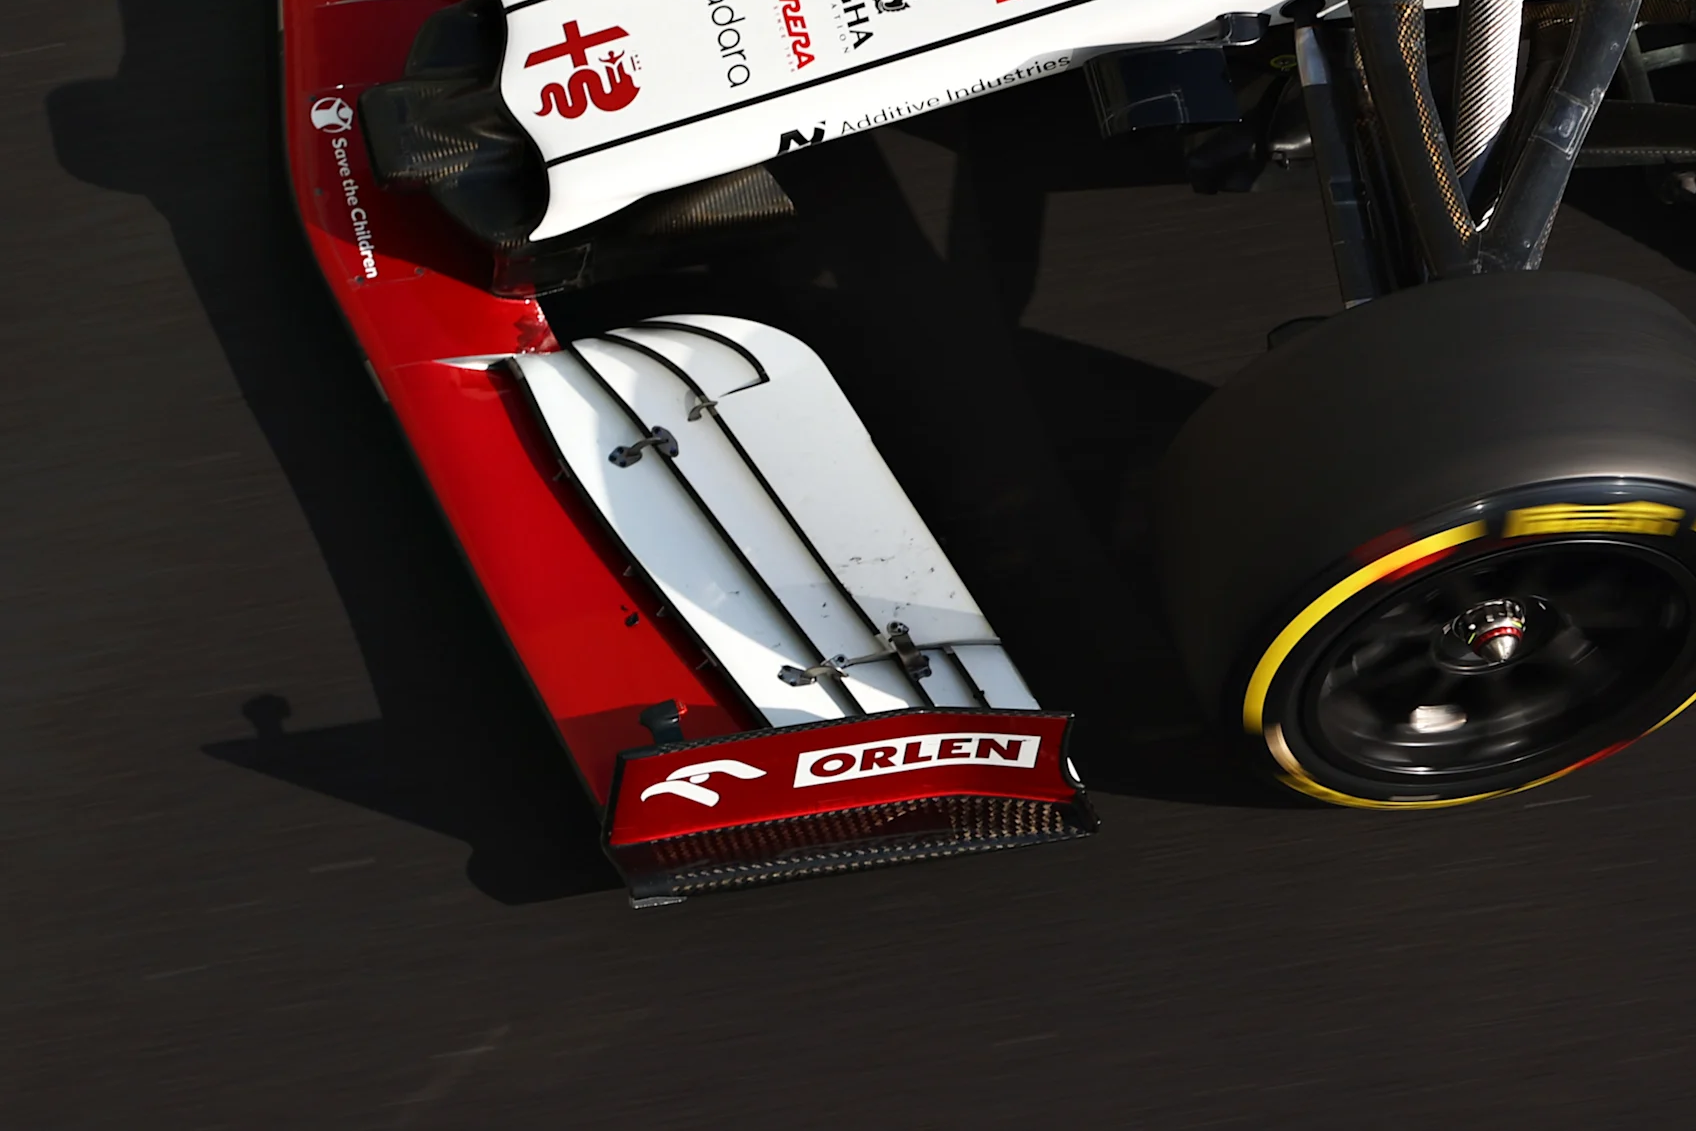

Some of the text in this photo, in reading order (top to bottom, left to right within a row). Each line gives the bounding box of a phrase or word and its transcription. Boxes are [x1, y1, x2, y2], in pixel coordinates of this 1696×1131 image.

[840, 54, 1071, 135] Additive Industries
[332, 137, 378, 279] Save the Children
[809, 737, 1027, 777] ORLEN
